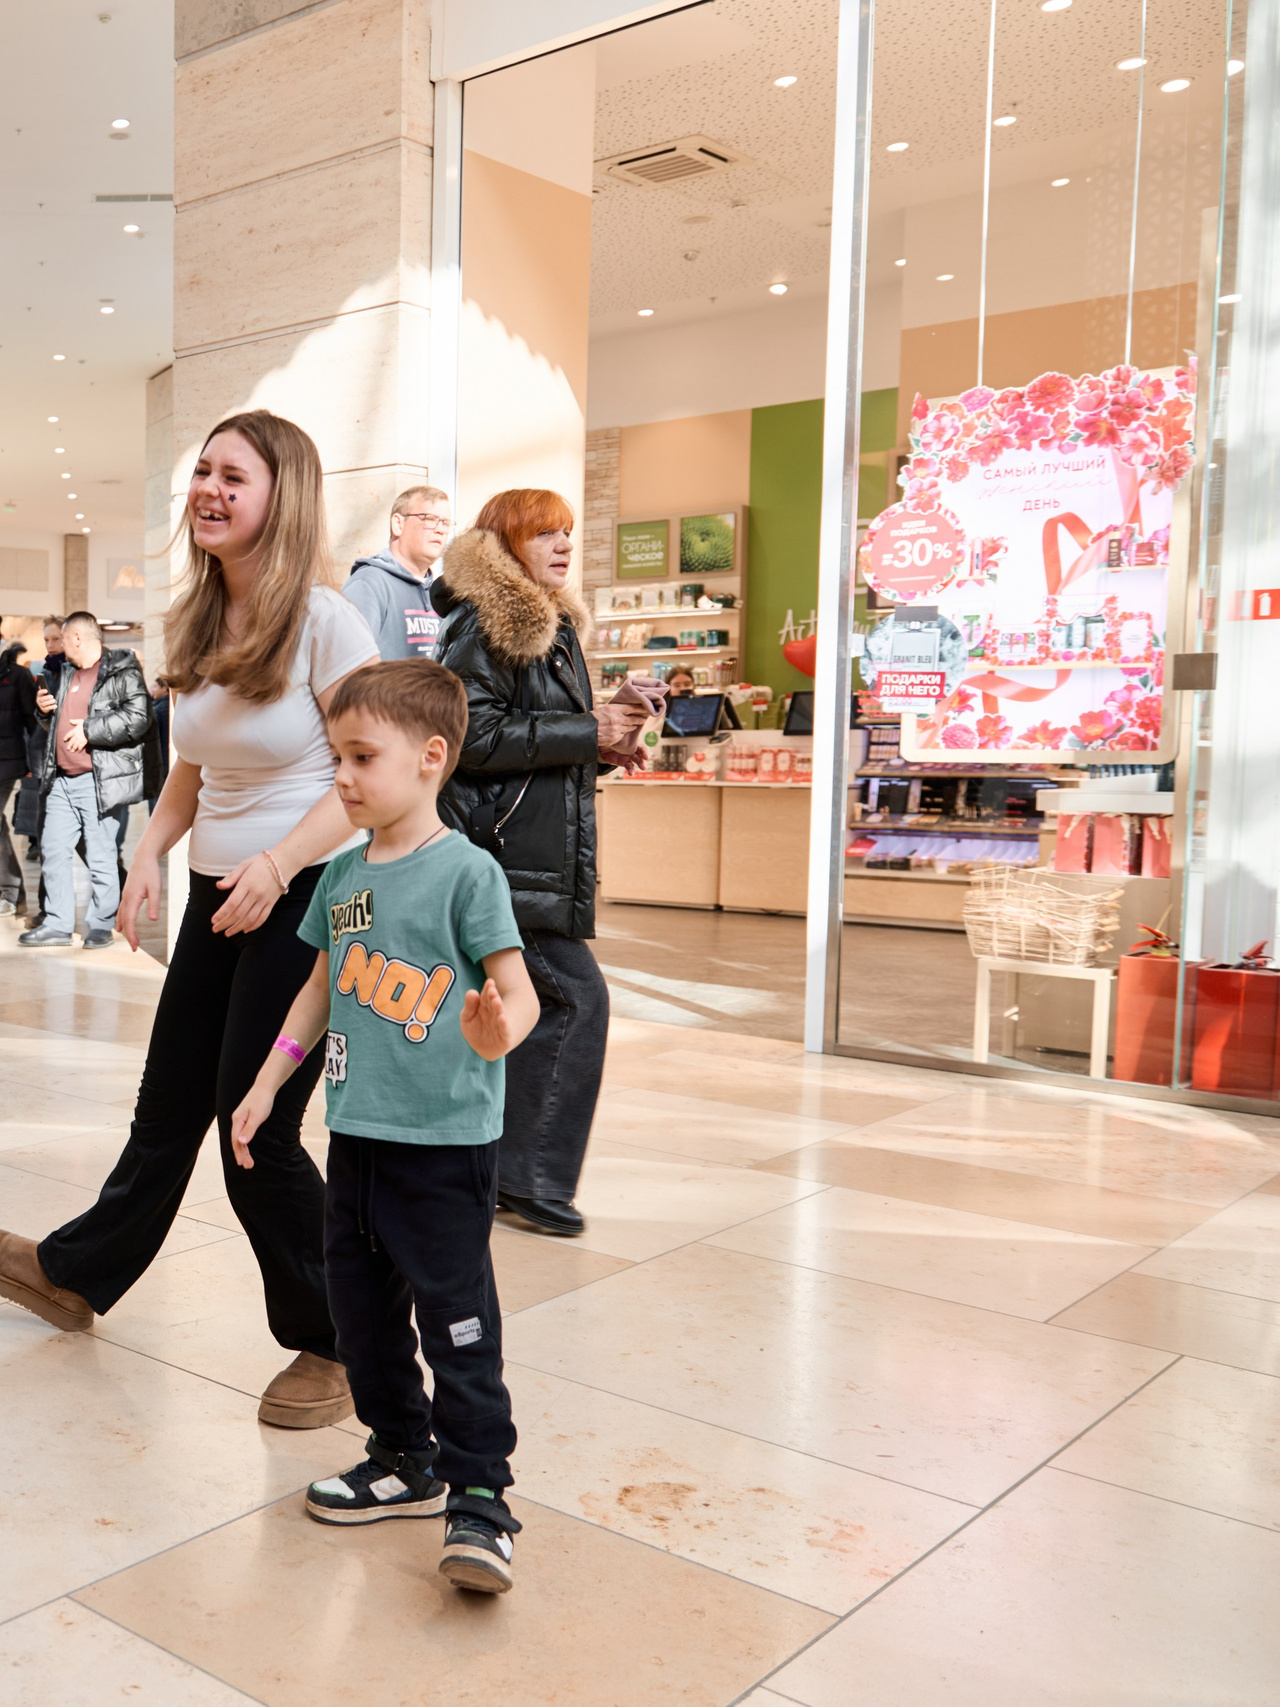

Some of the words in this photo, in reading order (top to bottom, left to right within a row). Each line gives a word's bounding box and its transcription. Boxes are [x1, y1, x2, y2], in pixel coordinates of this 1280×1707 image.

[983, 463, 1036, 480] САМЫЙ
[1041, 455, 1106, 474] ЛУЧШИЙ
[1023, 499, 1061, 511] ДЕНЬ
[405, 617, 440, 635] MUST
[881, 673, 941, 685] ПОДАРКИ
[880, 684, 906, 696] ДЛЯ
[907, 685, 941, 696] НЕГО
[331, 892, 373, 942] yeah!
[337, 941, 456, 1043] NO!
